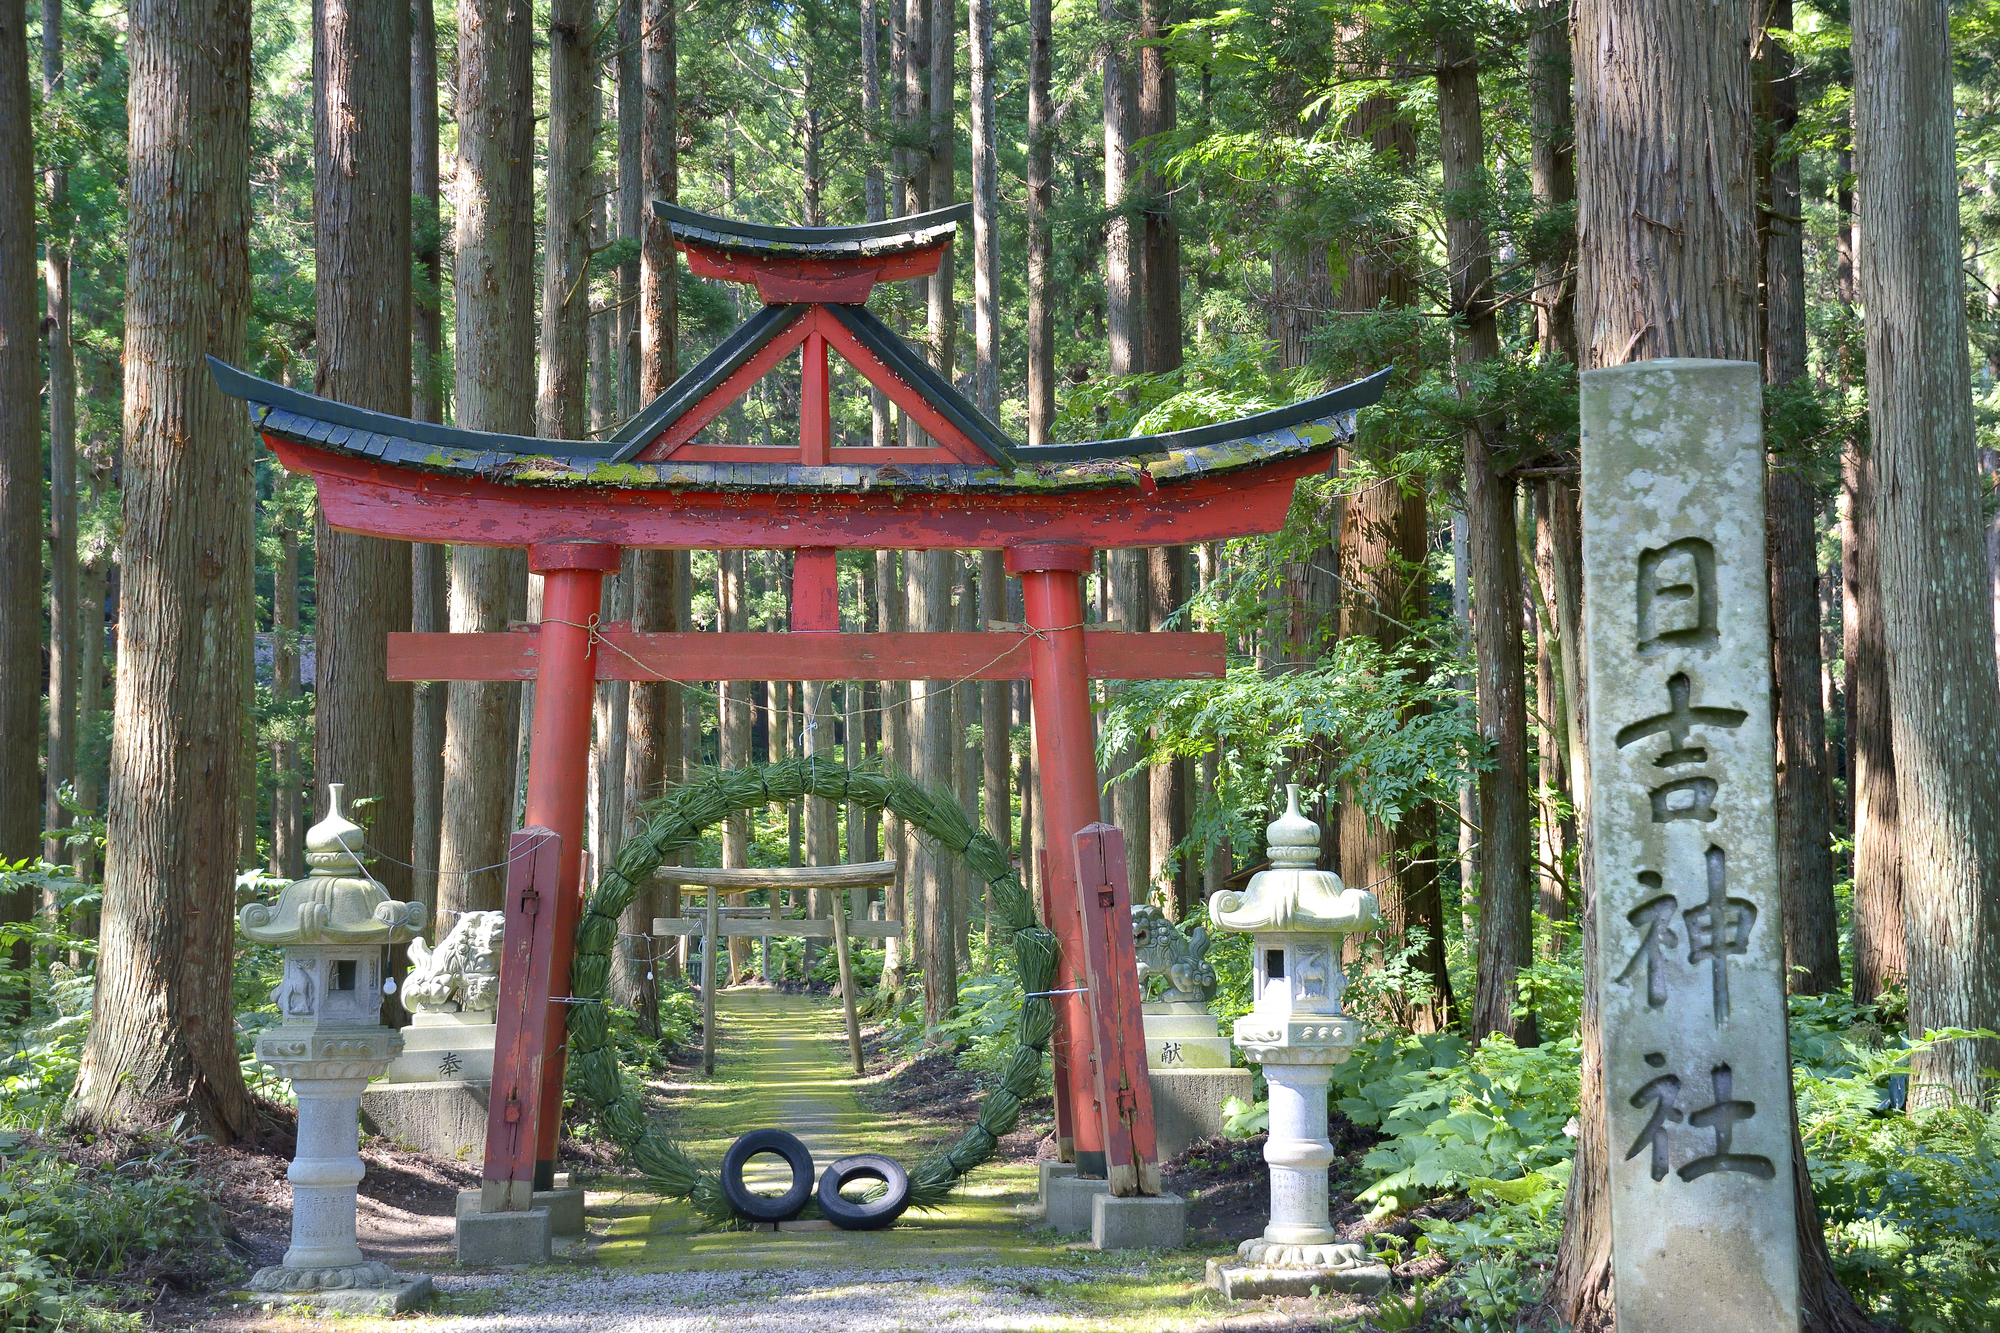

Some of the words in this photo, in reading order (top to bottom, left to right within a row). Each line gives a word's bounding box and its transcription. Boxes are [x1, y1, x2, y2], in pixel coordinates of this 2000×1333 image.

[1616, 536, 1774, 1181] 日吉神社
[438, 1051, 463, 1078] 奉
[1161, 1041, 1184, 1064] 献
